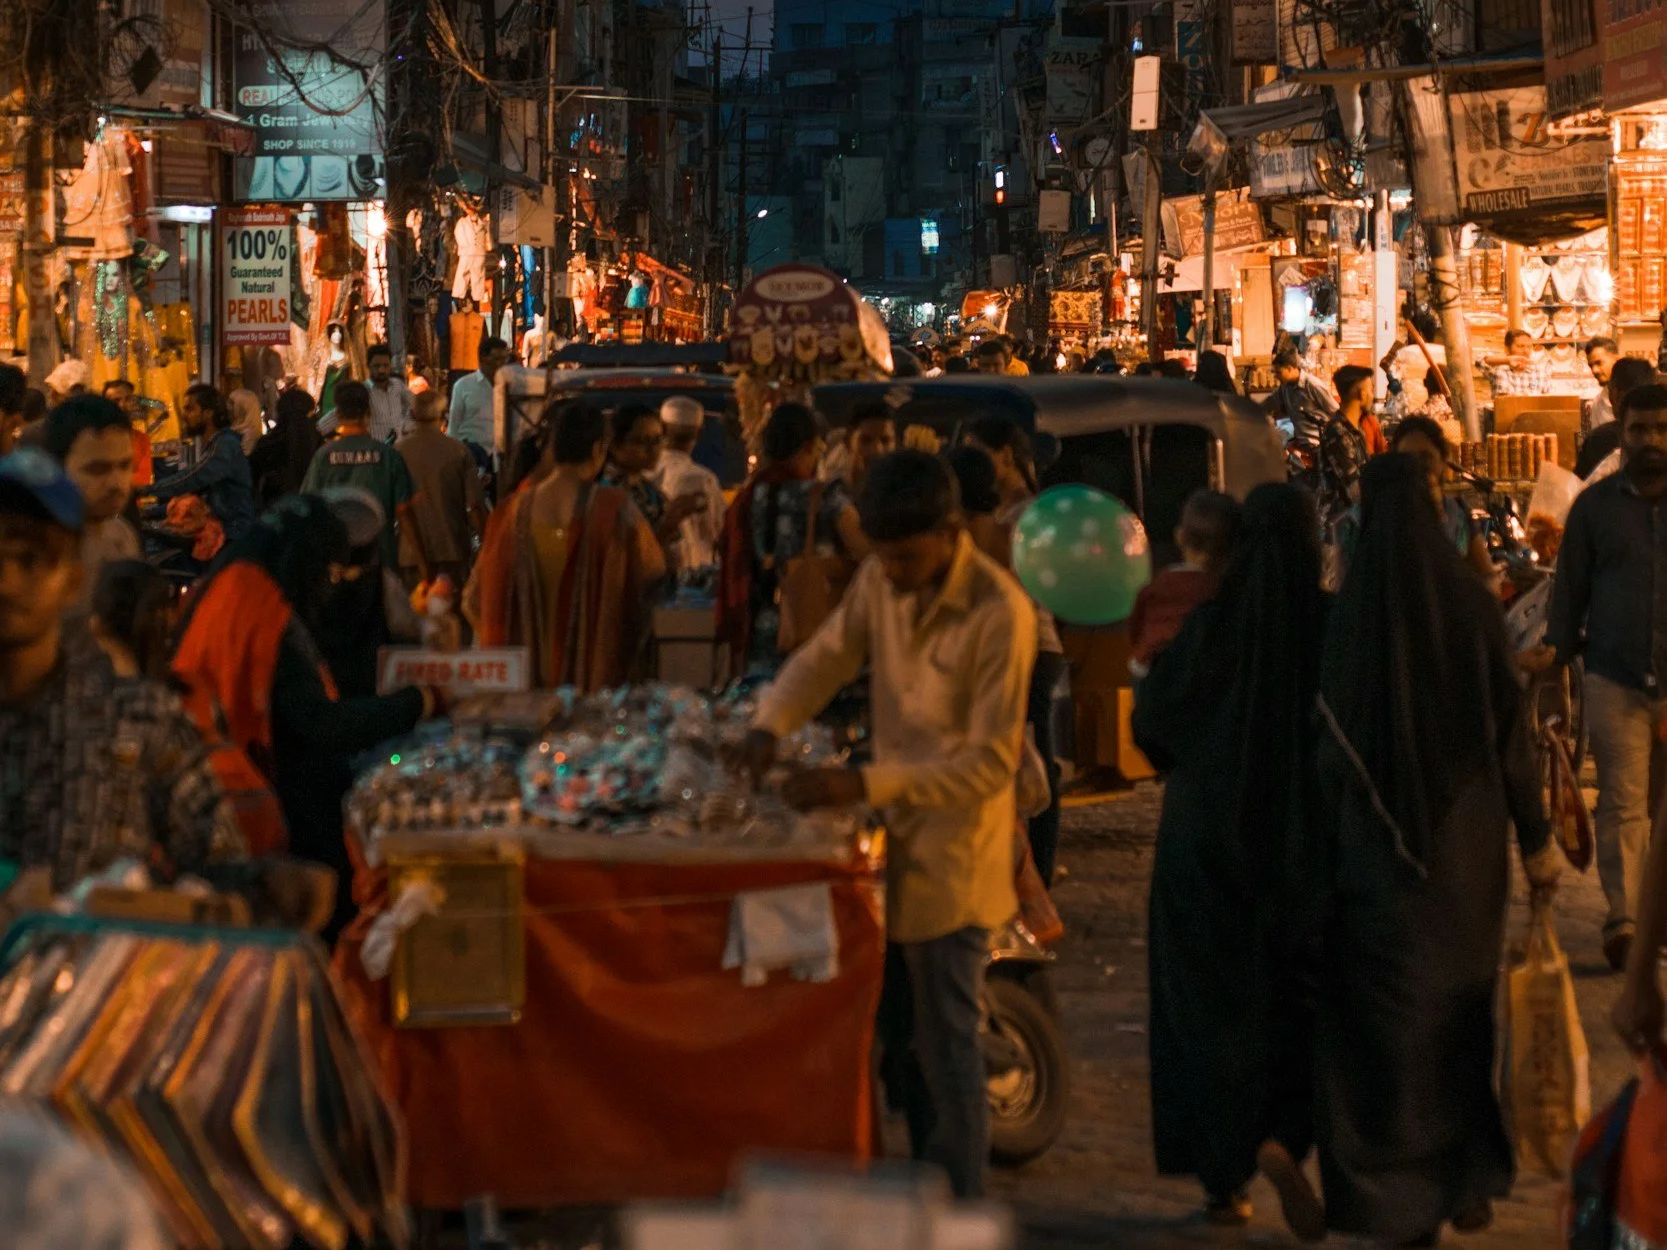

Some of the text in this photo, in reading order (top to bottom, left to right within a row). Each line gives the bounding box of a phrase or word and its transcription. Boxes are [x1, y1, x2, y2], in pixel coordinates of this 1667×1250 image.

[259, 112, 298, 127] Gram
[262, 138, 295, 151] SHOP
[296, 137, 330, 151] SINCE
[1469, 189, 1529, 214] WHOLESALE
[227, 229, 287, 261] 100%
[230, 265, 284, 279] Guaranteed
[241, 281, 275, 294] Natural
[227, 297, 288, 325] PEARLS
[458, 661, 508, 684] RATE
